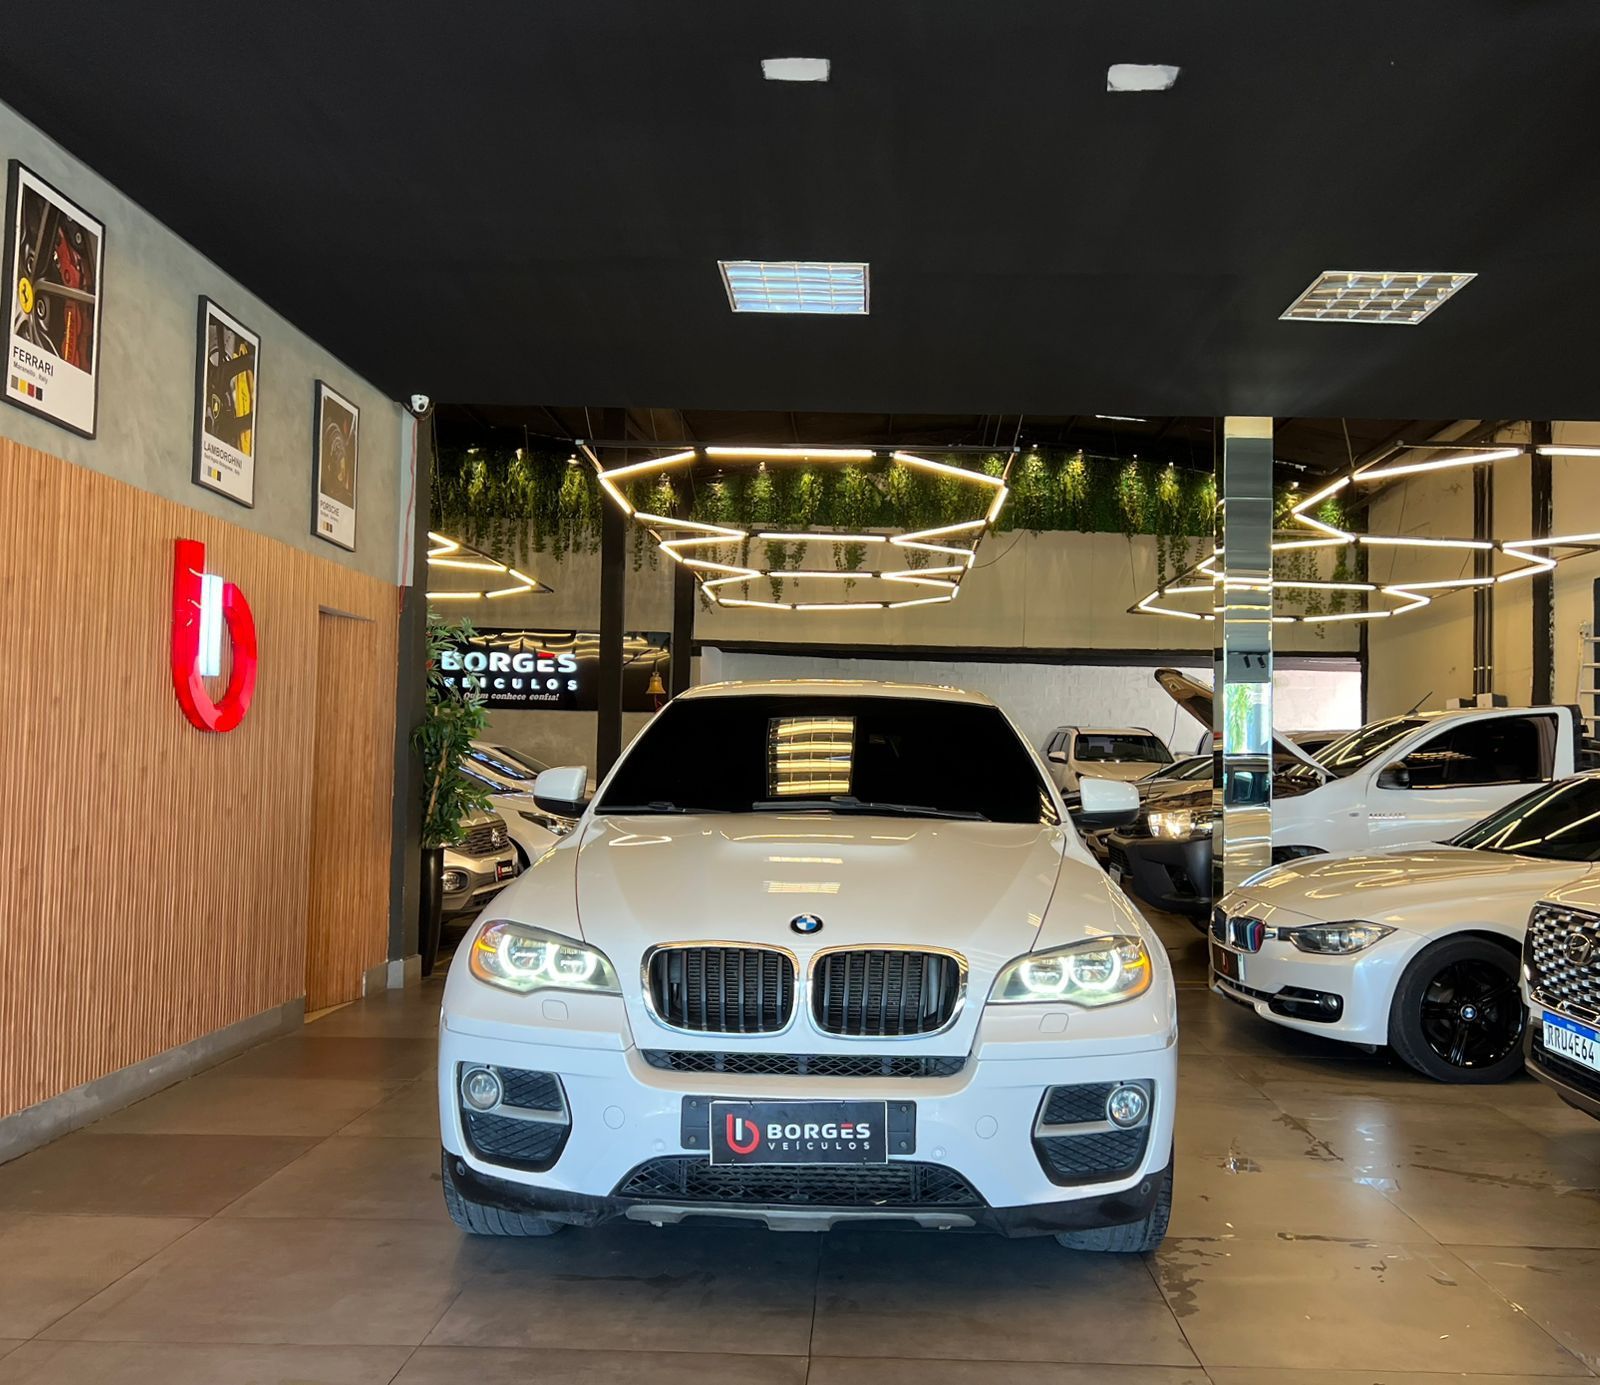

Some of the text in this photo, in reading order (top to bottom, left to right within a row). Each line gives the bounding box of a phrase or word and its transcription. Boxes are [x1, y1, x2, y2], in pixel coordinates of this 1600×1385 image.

[13, 345, 54, 377] FERRARI
[203, 440, 243, 469] LAMBORGHINI
[441, 651, 577, 673] BORGES
[463, 692, 560, 702] Qum conhece confia!
[1547, 1024, 1595, 1064] RRU4E64
[767, 1122, 871, 1139] BORGES
[767, 1141, 871, 1151] VEÍCULOS
